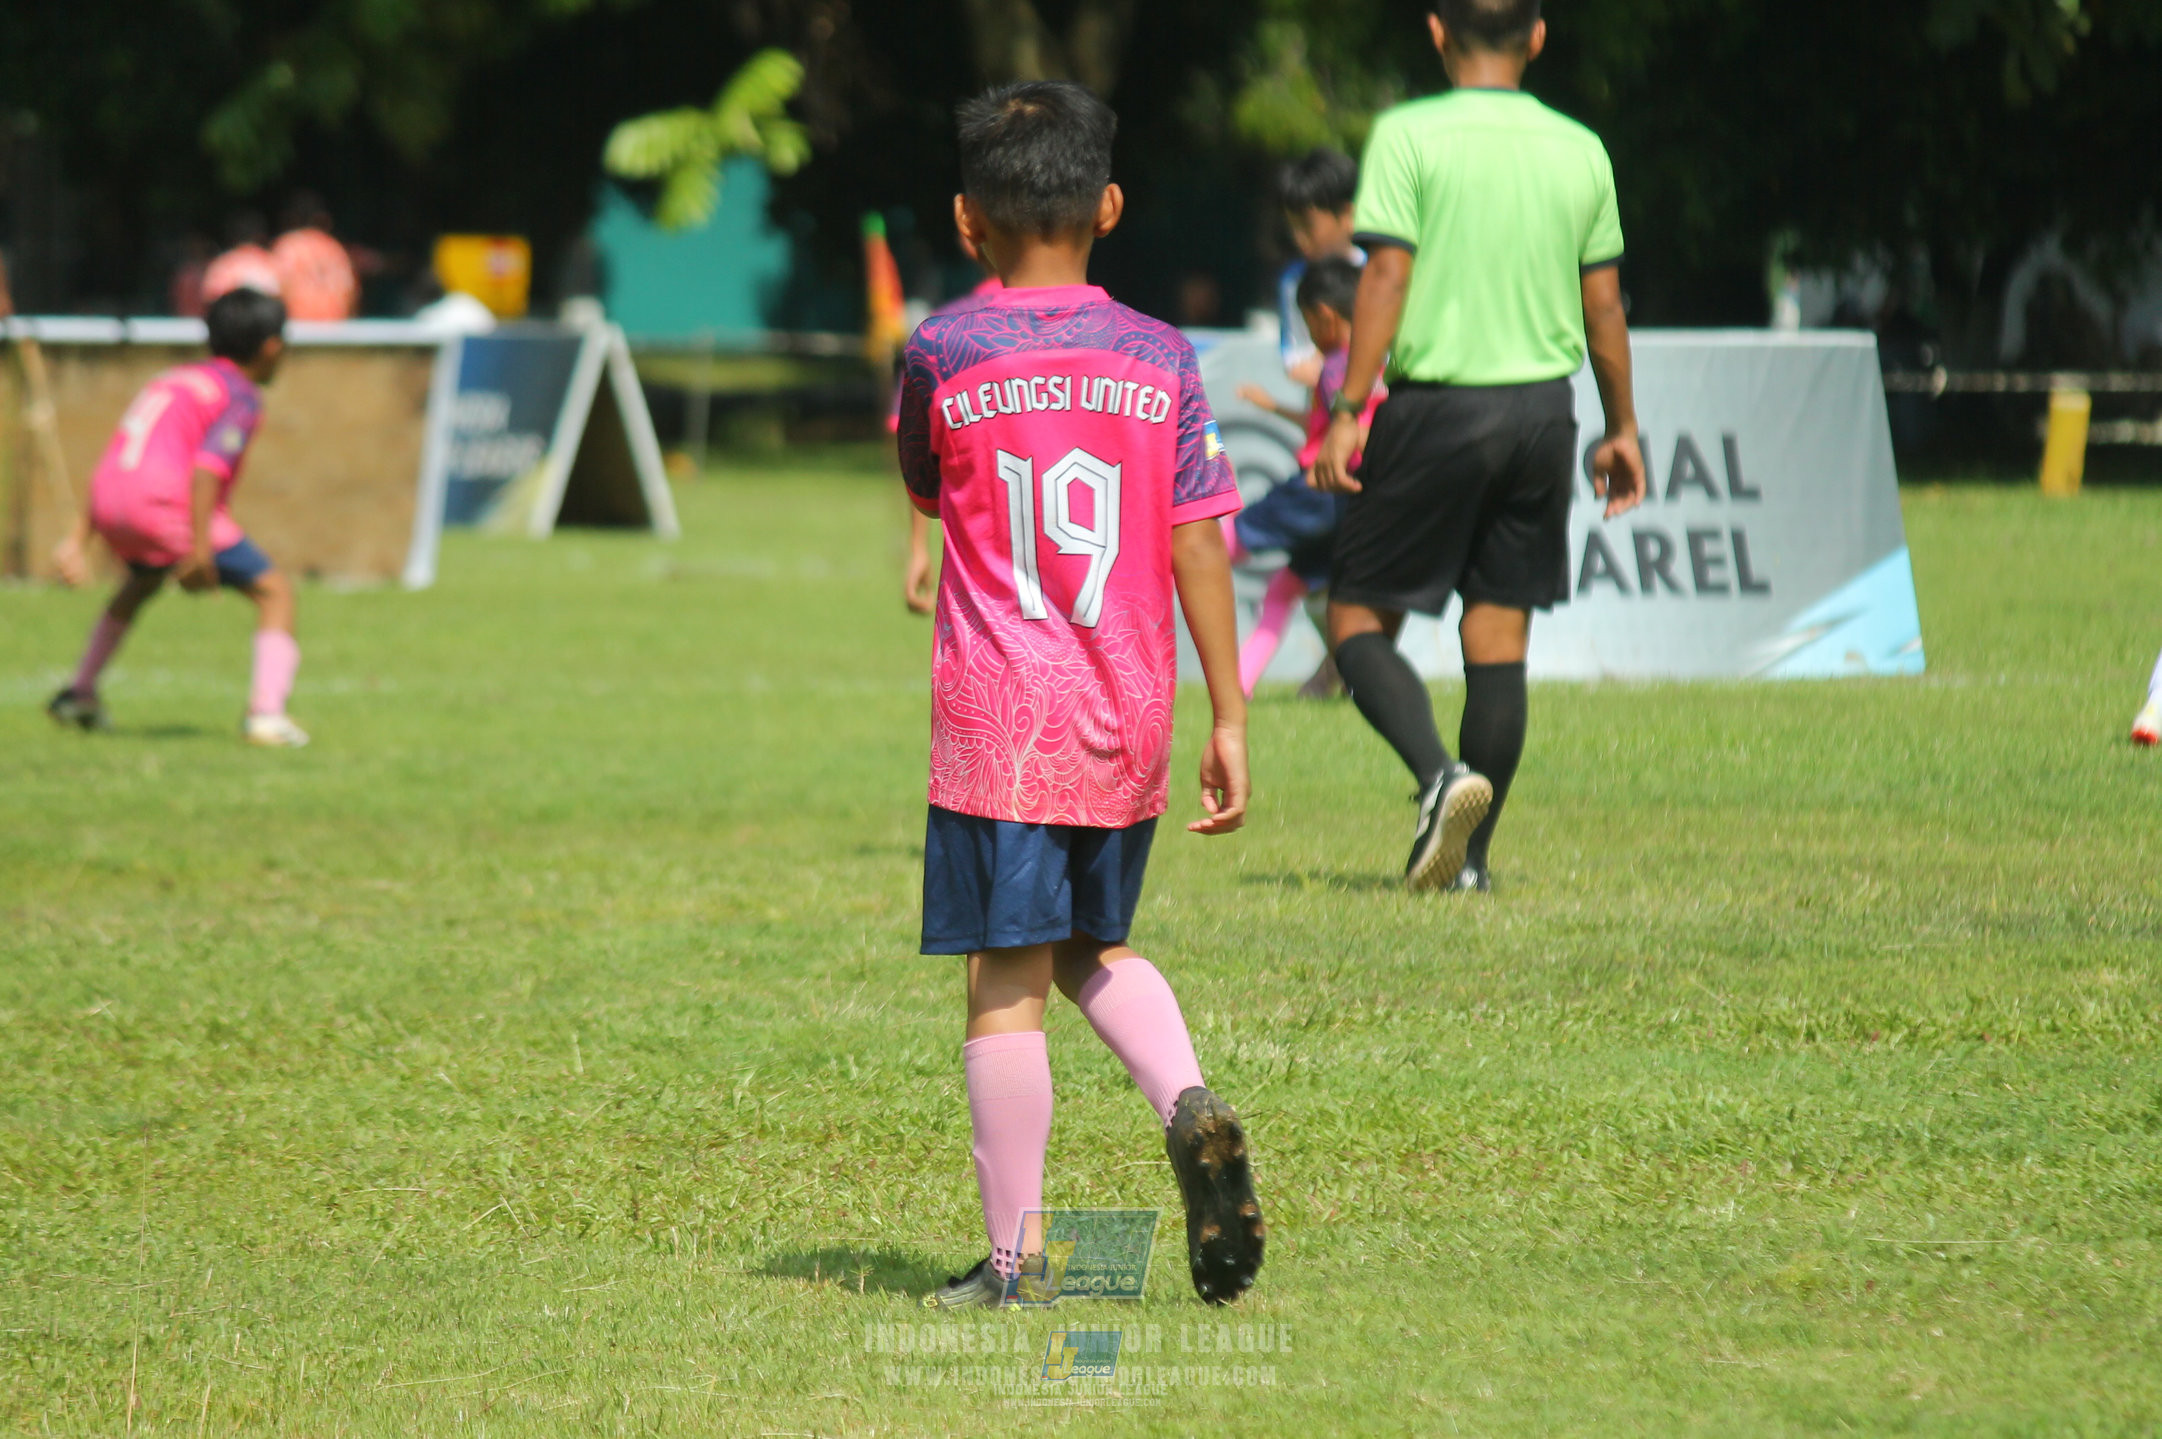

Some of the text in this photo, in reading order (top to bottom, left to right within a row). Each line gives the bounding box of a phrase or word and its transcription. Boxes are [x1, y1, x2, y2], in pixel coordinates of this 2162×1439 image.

[941, 376, 1172, 429] CILEUNGSI UNITED
[996, 447, 1122, 628] 19
